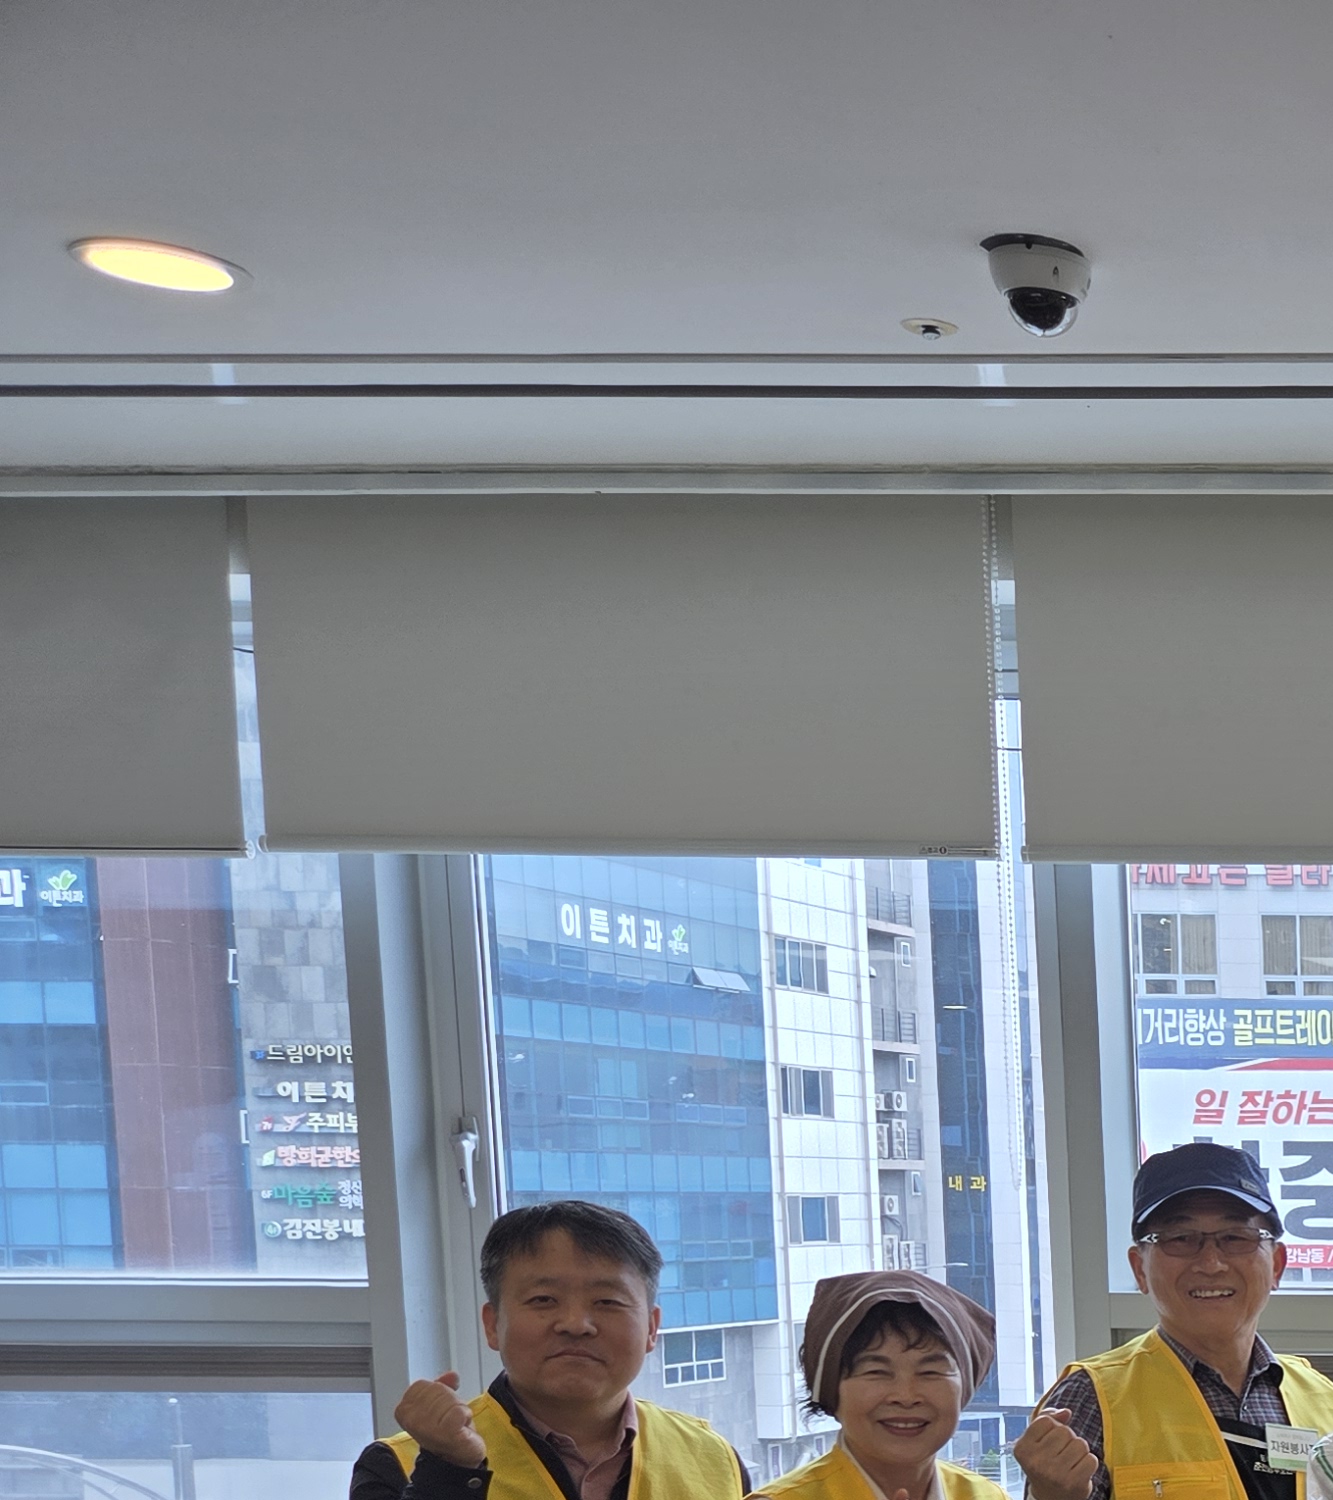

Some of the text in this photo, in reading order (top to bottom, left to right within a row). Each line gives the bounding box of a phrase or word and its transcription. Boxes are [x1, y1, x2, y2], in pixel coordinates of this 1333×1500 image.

[40, 890, 84, 907] 이튼치과
[561, 903, 663, 953] 이튼치과
[1193, 1088, 1229, 1125] 일
[273, 1181, 336, 1208] 마음숲
[948, 1174, 987, 1192] 내과
